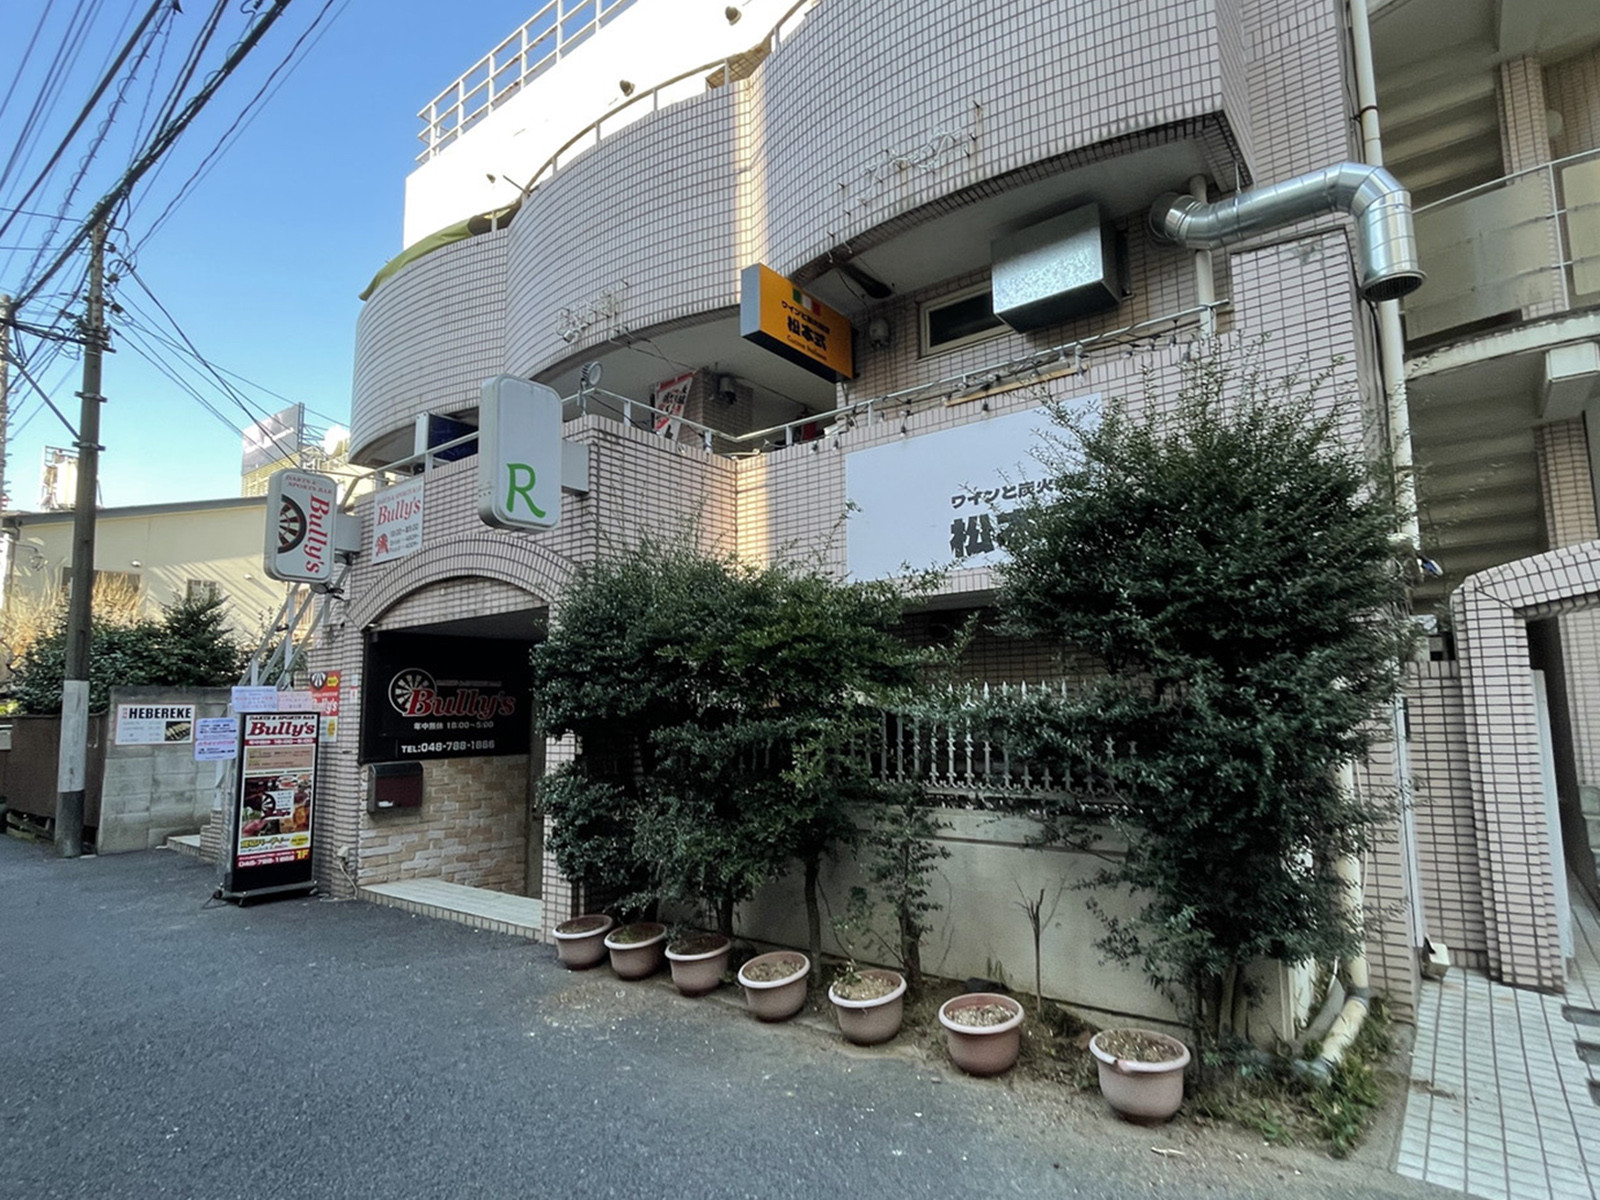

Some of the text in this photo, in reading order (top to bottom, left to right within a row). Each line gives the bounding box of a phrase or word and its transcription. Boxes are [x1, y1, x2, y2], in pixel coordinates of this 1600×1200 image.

[506, 463, 546, 518] R
[376, 496, 421, 526] Bully's
[303, 493, 330, 574] Bully's
[129, 707, 192, 719] HEBEREKE
[402, 688, 516, 720] Bully's
[247, 721, 315, 737] Bully's
